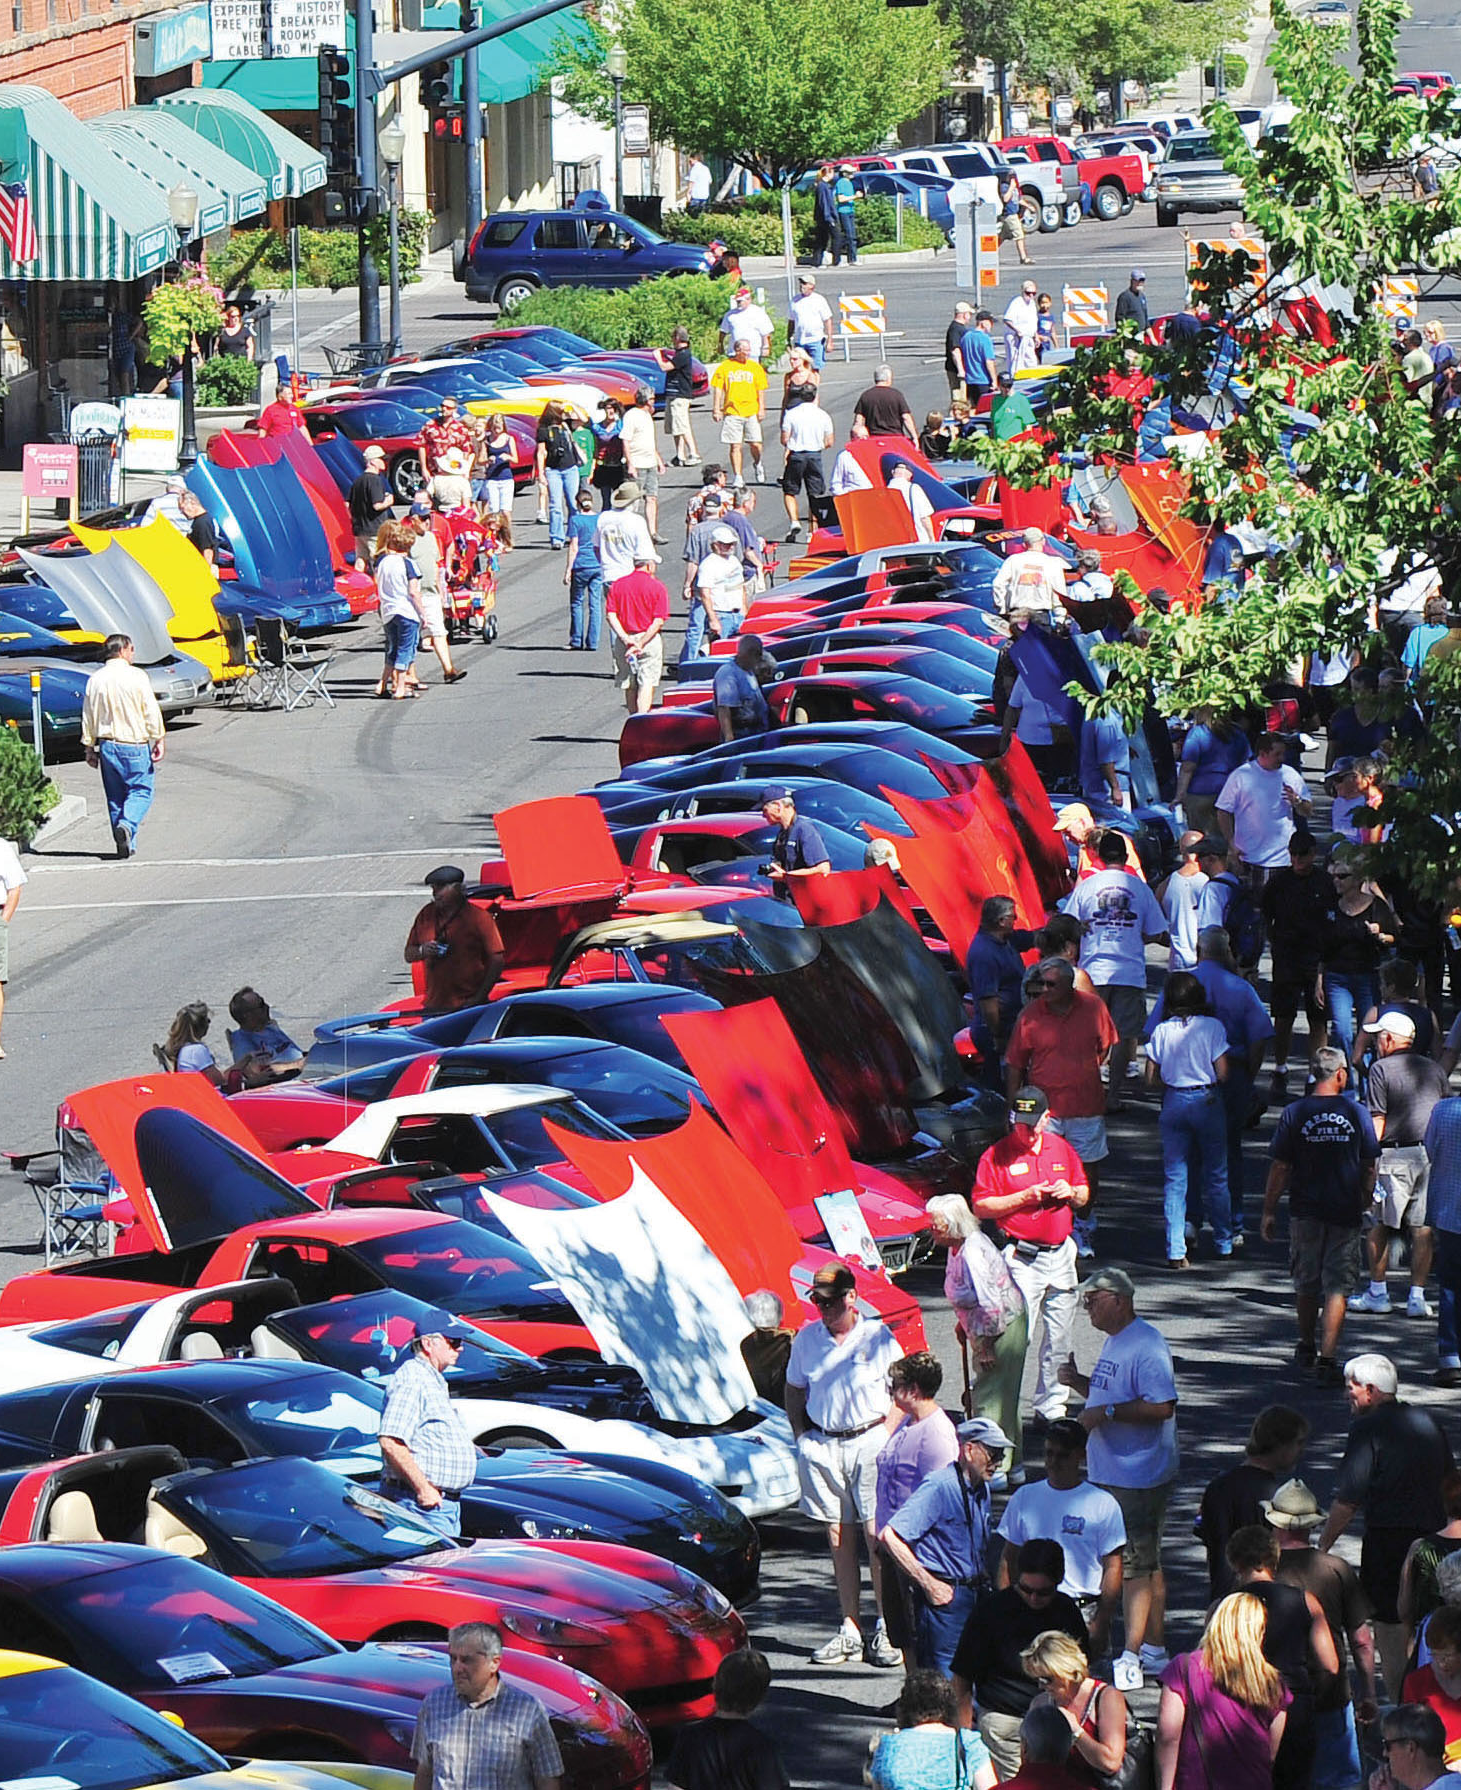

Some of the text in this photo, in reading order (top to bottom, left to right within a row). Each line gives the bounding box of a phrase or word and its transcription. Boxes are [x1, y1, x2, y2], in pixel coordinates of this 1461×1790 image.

[214, 1, 340, 16] EXPERIENCE HISTORY
[215, 18, 242, 30] FREE
[280, 15, 341, 27] BREAKFAST
[280, 29, 316, 40] ROOMS
[228, 45, 263, 56] CABLE
[1301, 1112, 1355, 1136] PRESCOTT
